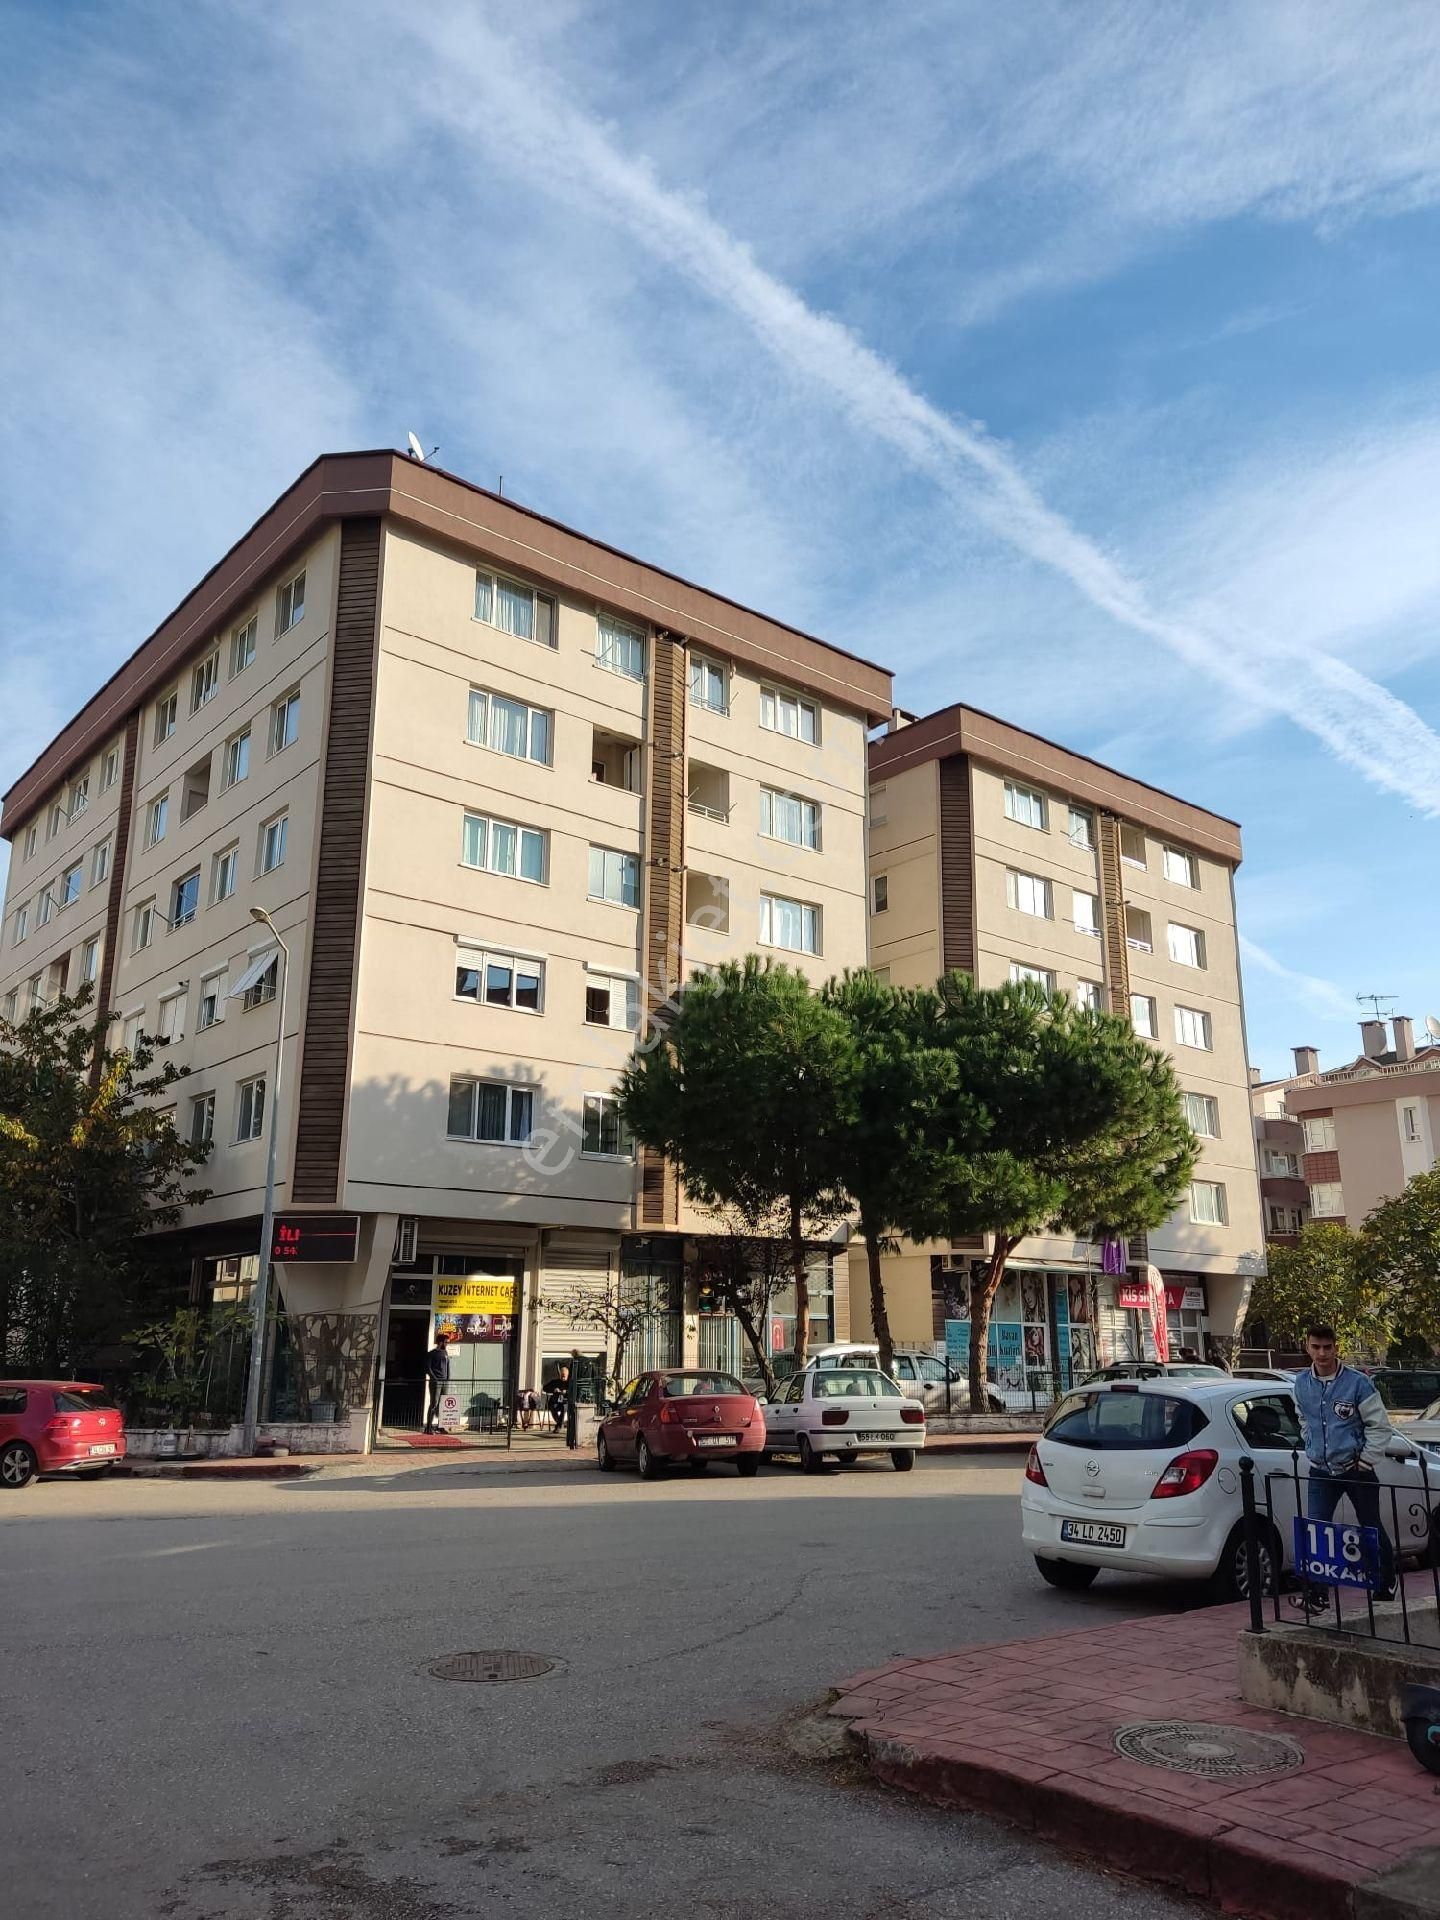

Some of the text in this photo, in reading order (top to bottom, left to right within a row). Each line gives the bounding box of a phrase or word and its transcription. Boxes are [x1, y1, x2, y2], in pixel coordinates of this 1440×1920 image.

[438, 1284, 463, 1297] KUZEY
[500, 1286, 518, 1299] CAFE
[1068, 1523, 1079, 1537] 34
[1097, 1526, 1122, 1543] 2450
[1307, 1523, 1362, 1563] 118
